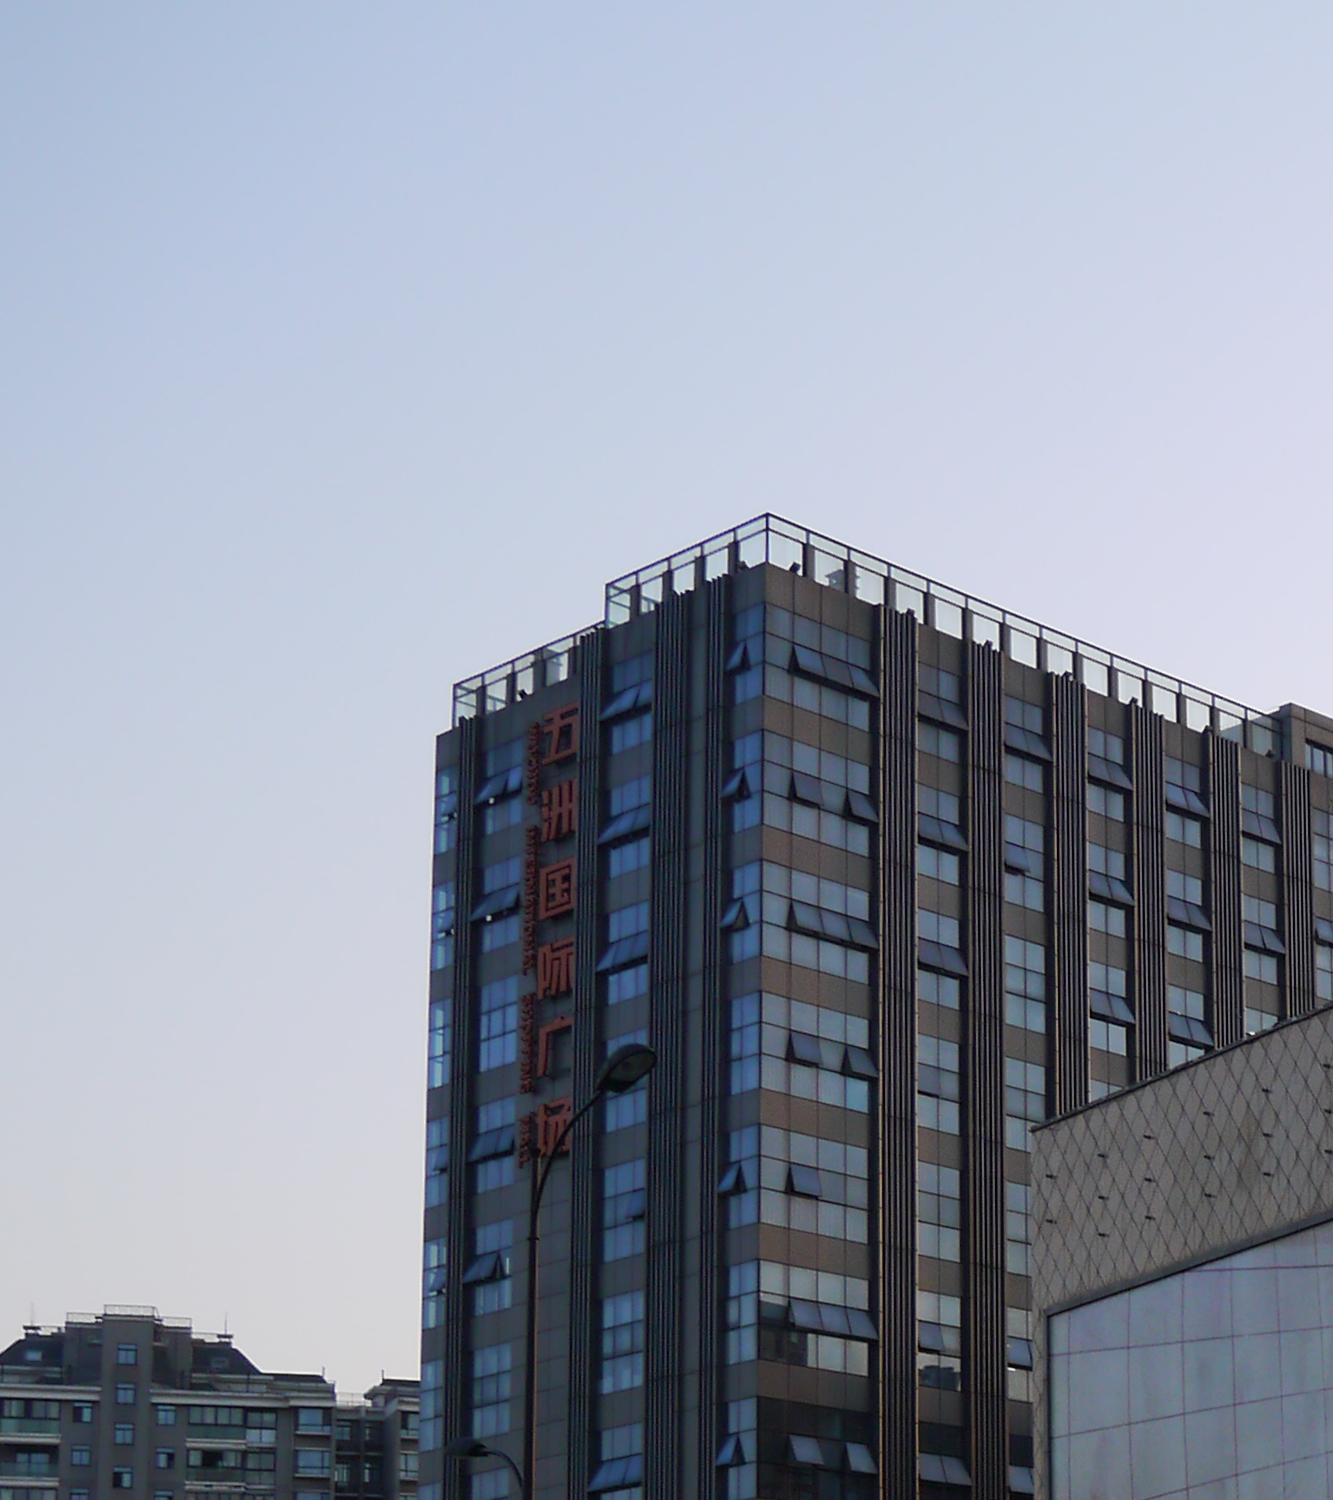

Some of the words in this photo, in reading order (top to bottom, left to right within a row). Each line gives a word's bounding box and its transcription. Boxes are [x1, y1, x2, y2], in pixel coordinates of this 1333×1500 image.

[539, 700, 578, 1160] 五洲国际广场
